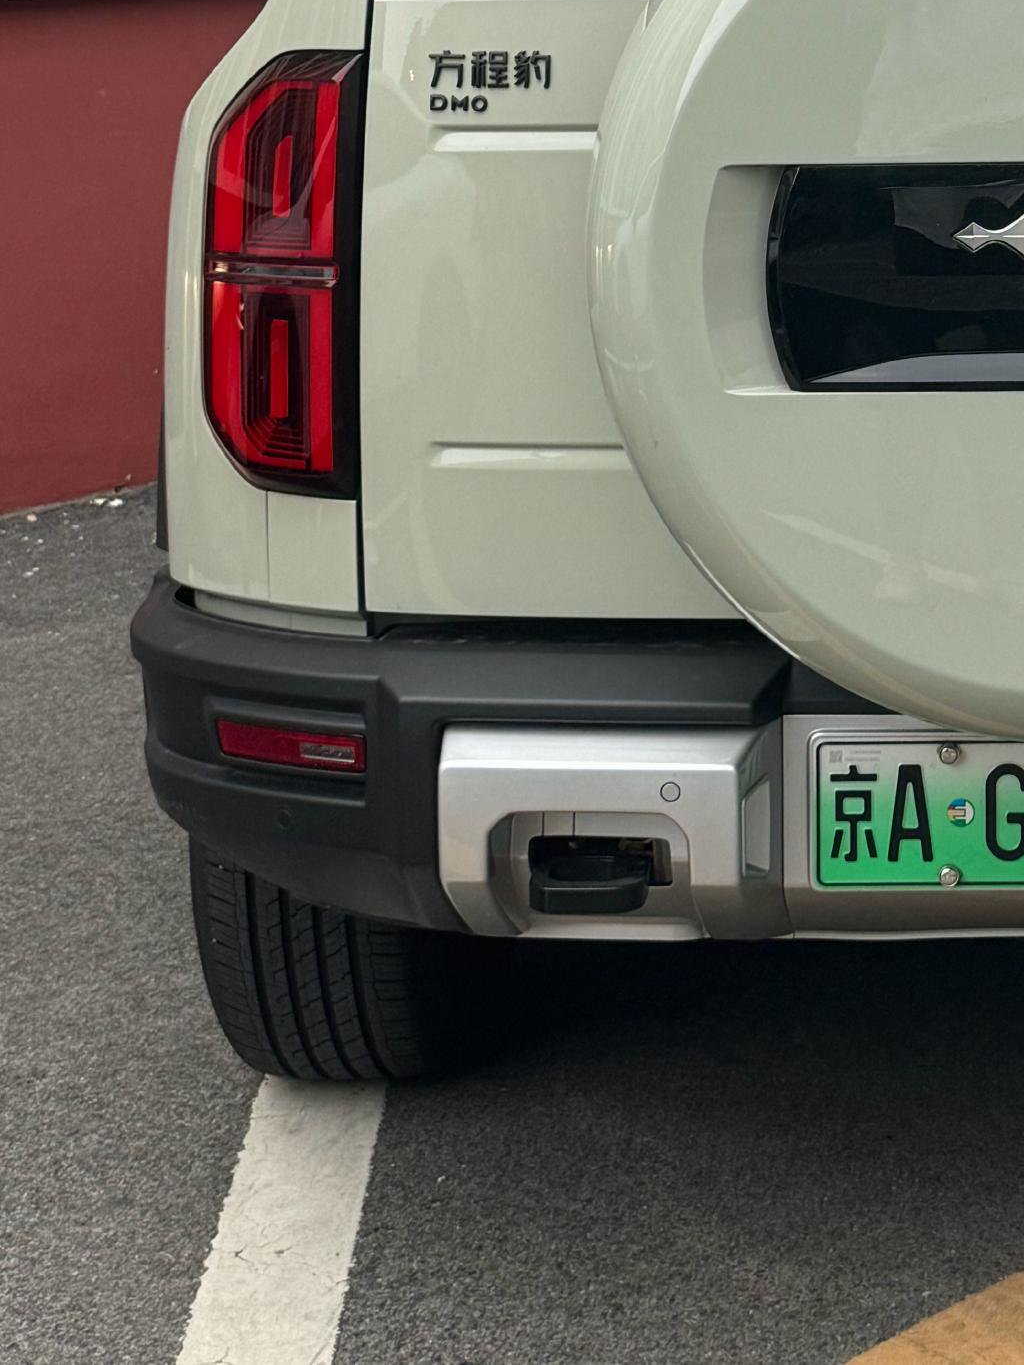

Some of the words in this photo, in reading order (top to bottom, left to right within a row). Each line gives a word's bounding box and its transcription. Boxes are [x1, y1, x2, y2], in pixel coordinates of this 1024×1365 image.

[428, 49, 552, 89] 方程豹
[429, 93, 489, 113] DMO
